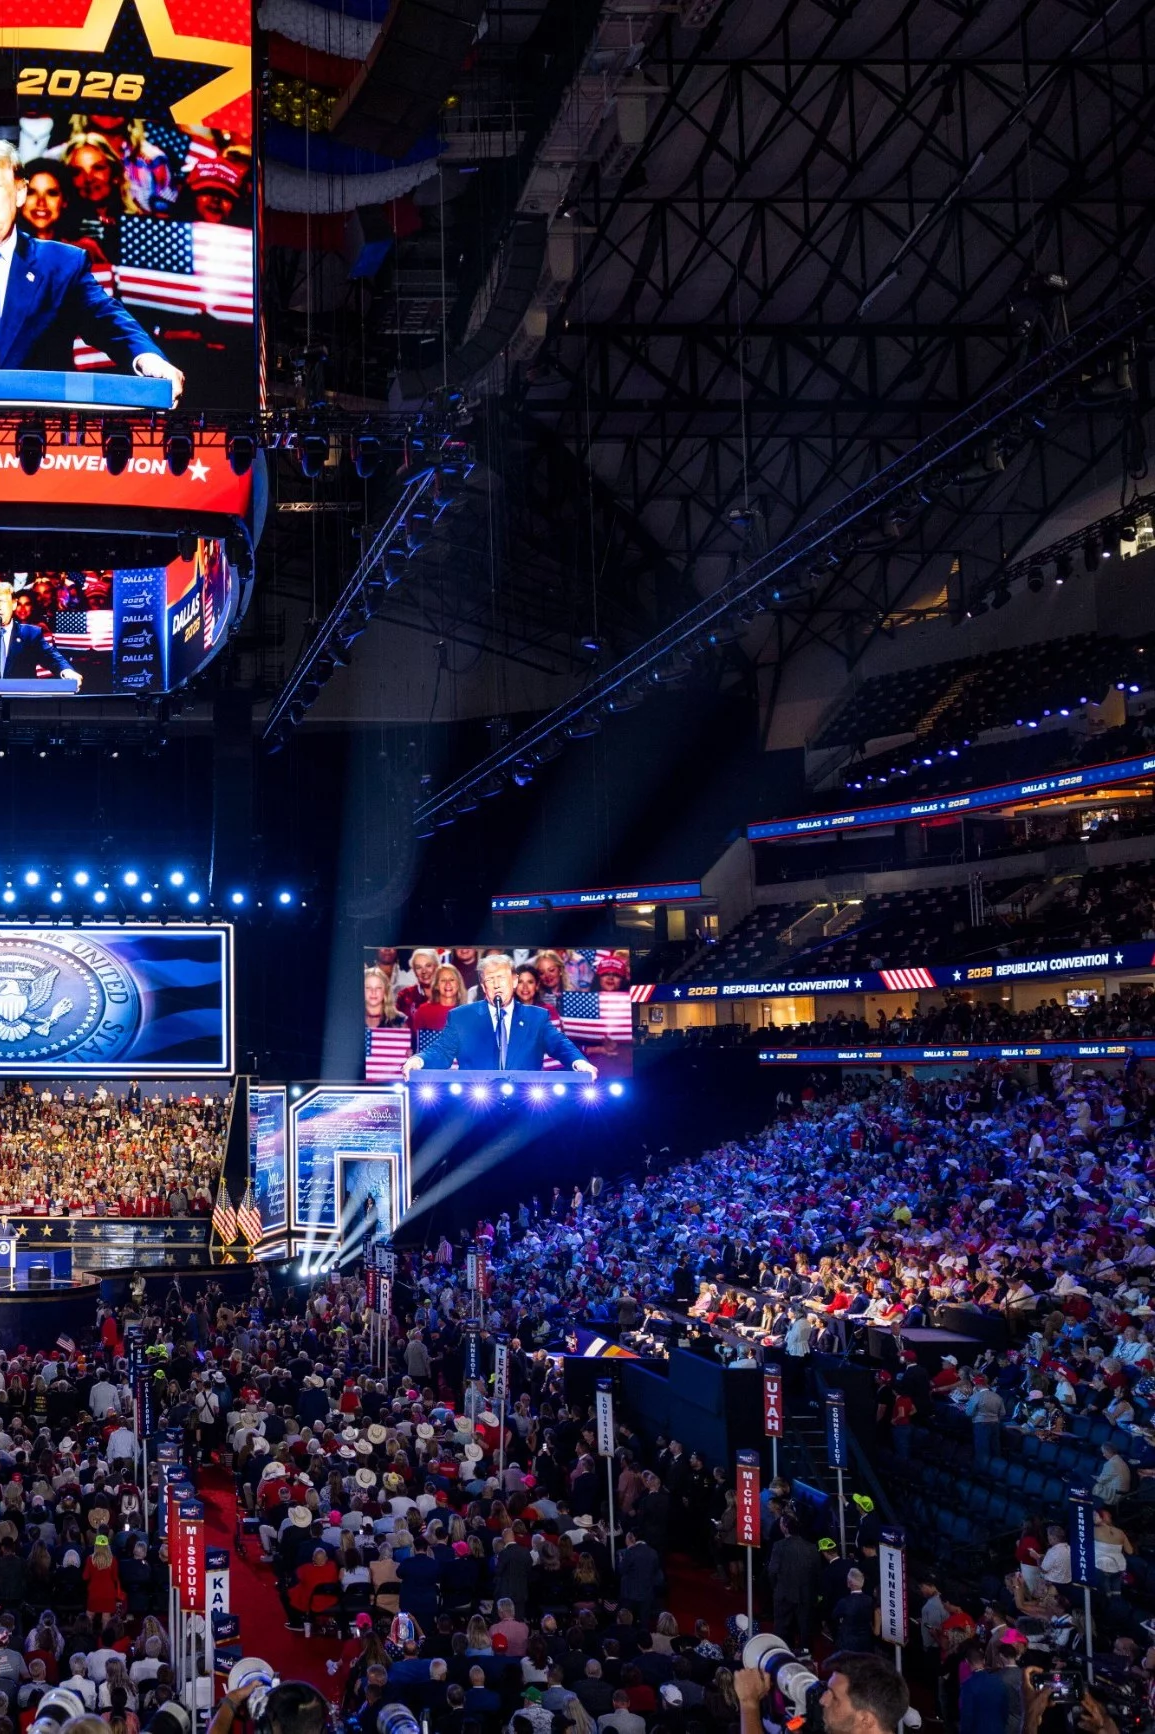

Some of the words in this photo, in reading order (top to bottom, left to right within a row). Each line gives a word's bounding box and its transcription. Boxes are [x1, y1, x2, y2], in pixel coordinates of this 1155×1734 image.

[16, 67, 146, 101] 2026
[38, 453, 168, 475] ONVEION
[122, 574, 153, 584] DALLAS
[122, 614, 153, 623] DALLAS
[172, 592, 201, 636] DALLAS
[122, 653, 154, 662] DALLAS
[1143, 760, 1155, 770] DAL
[1021, 782, 1047, 794] DALLAS
[1057, 775, 1083, 787] 2026
[910, 803, 938, 814] DALLAS
[796, 819, 822, 830] DALLAS
[580, 893, 605, 902] DALLAS
[71, 940, 130, 1005] UNITED
[967, 966, 993, 980] 2026
[996, 960, 1047, 976] REPUBLICAN
[1050, 953, 1109, 971] CONVENTION
[687, 986, 718, 996] 2026
[722, 983, 786, 995] REPUBLICAN
[788, 978, 850, 992] CONVENTION
[923, 1050, 945, 1058] DALLAS
[1001, 1048, 1019, 1056] DALLAS
[1079, 1046, 1099, 1055] DALLAS
[497, 1348, 505, 1395] TEXAS
[766, 1381, 779, 1431] UTAH
[602, 1396, 610, 1452] LOUISIANA
[832, 1407, 841, 1465] CONNECTICUT
[742, 1471, 753, 1541] MICHIGAN
[1077, 1505, 1088, 1582] PENNSYLVANIA
[186, 1525, 197, 1606] MISSOURI
[212, 1577, 224, 1613] KAN
[887, 1552, 896, 1636] TENNESSEE
[216, 1657, 233, 1666] DALLAS
